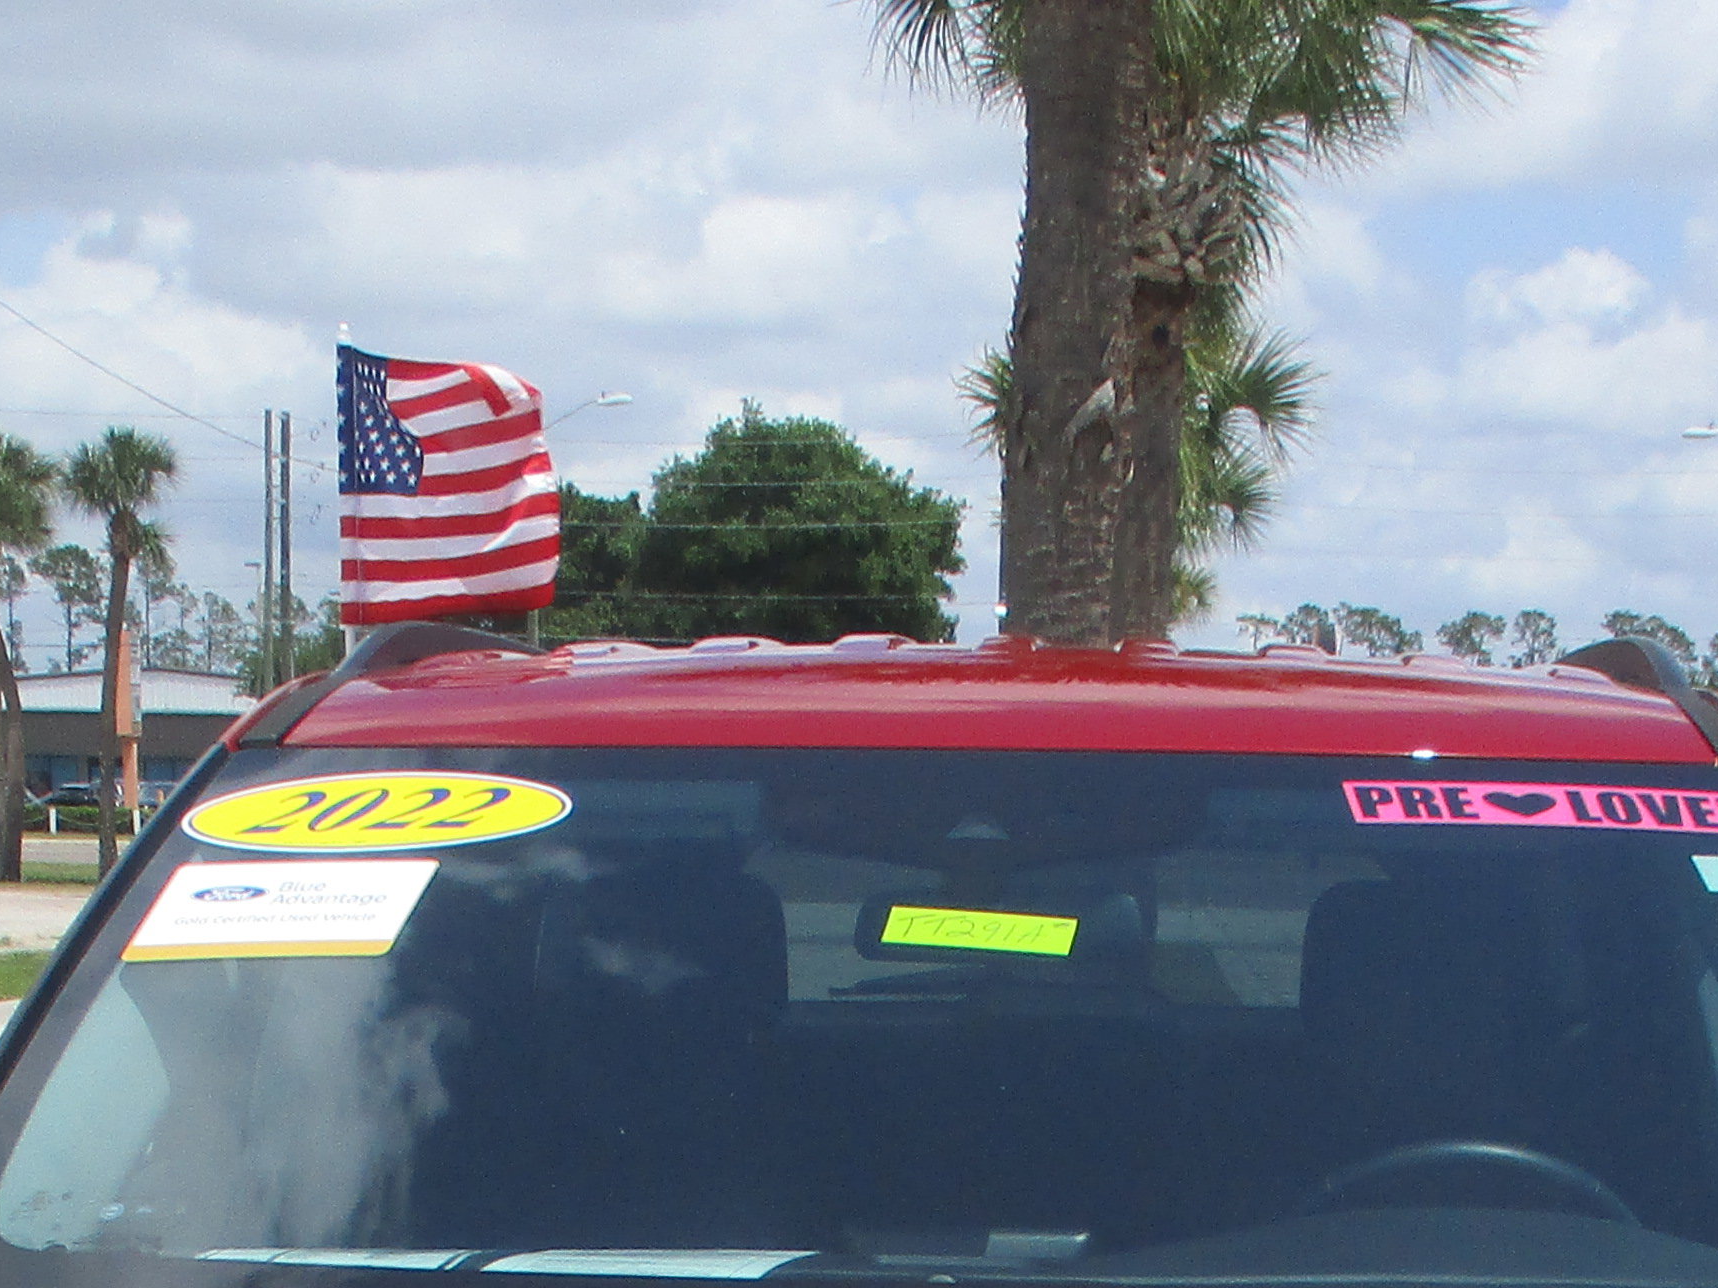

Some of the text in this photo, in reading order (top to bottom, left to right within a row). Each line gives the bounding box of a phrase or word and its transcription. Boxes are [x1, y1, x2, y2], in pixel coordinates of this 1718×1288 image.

[1352, 785, 1481, 821] PRE
[237, 788, 512, 834] 2022
[278, 881, 326, 893] Blue
[270, 893, 388, 906] Advantage
[174, 911, 377, 926] Gold Certified Used Vehicle
